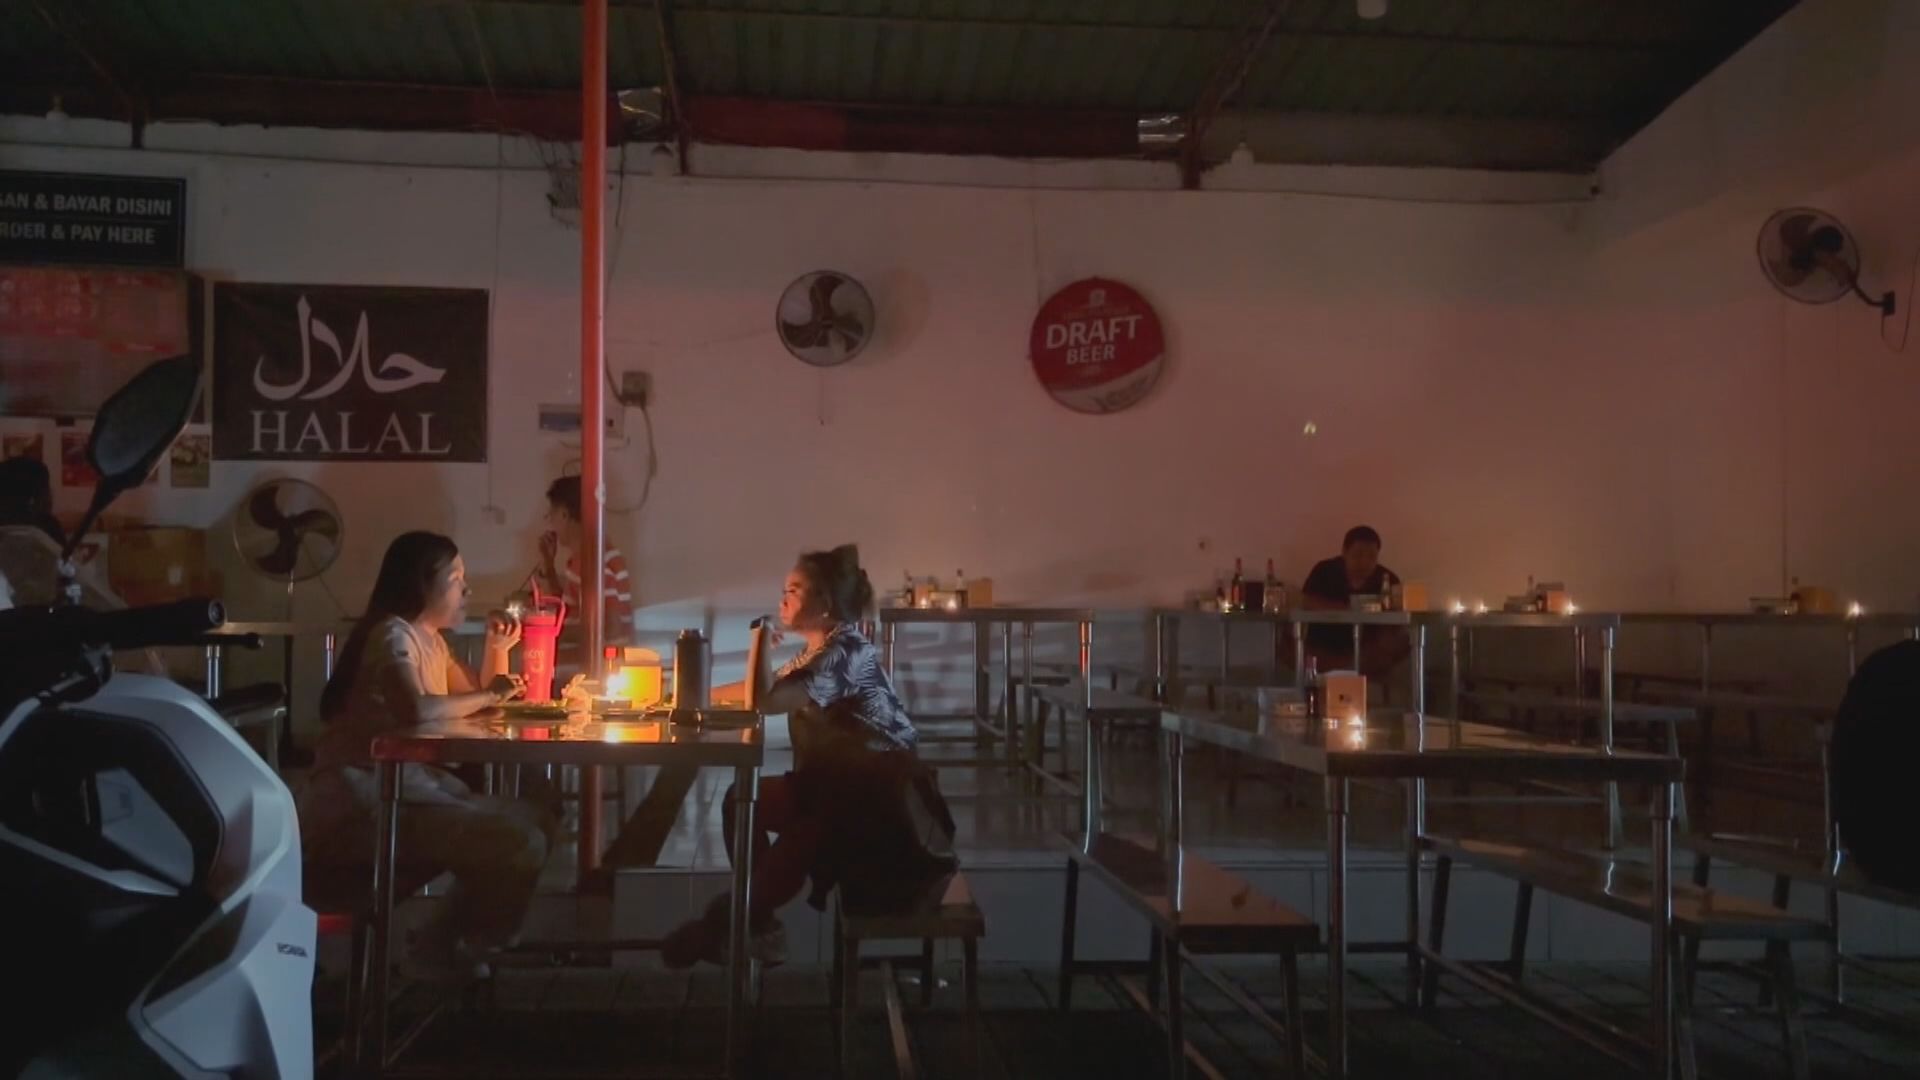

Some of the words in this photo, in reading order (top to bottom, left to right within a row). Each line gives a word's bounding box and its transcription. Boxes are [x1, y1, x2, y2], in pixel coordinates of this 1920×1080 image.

[34, 193, 48, 210] &
[54, 193, 111, 213] BAYAR
[116, 197, 171, 216] DISINI
[51, 224, 65, 240] &
[71, 224, 103, 242] PAY
[108, 226, 155, 244] HERE
[1046, 314, 1143, 350] DRAFT
[253, 294, 447, 400] حلال
[1066, 344, 1115, 366] BEER
[249, 409, 452, 454] HALAL
